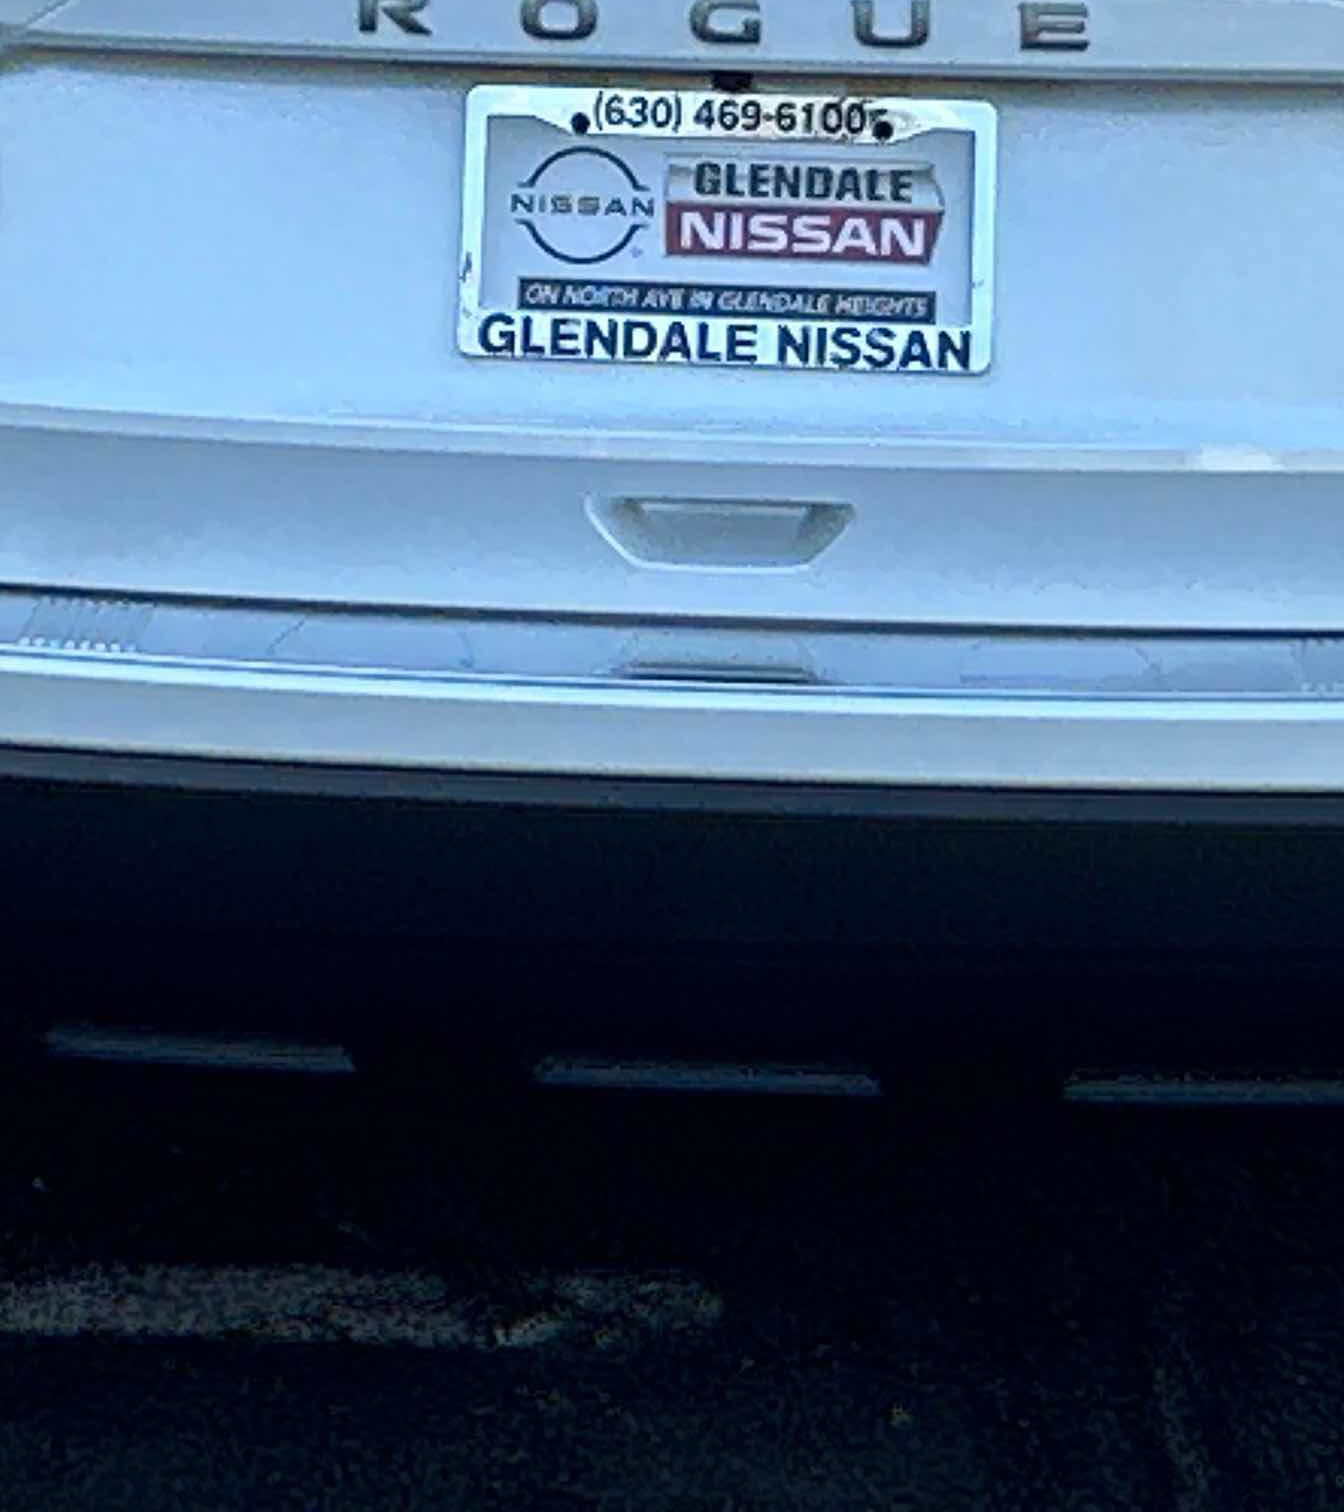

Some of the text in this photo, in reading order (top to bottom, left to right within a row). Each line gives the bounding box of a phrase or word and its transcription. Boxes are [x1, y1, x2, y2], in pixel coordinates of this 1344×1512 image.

[594, 90, 866, 134] (630) 469-6100
[694, 161, 913, 202] GLENDALE
[510, 193, 654, 217] NISSAN
[679, 212, 924, 256] NISSAN
[716, 290, 831, 315] GLENDALE
[478, 312, 971, 370] GLENDALE NISSAN
